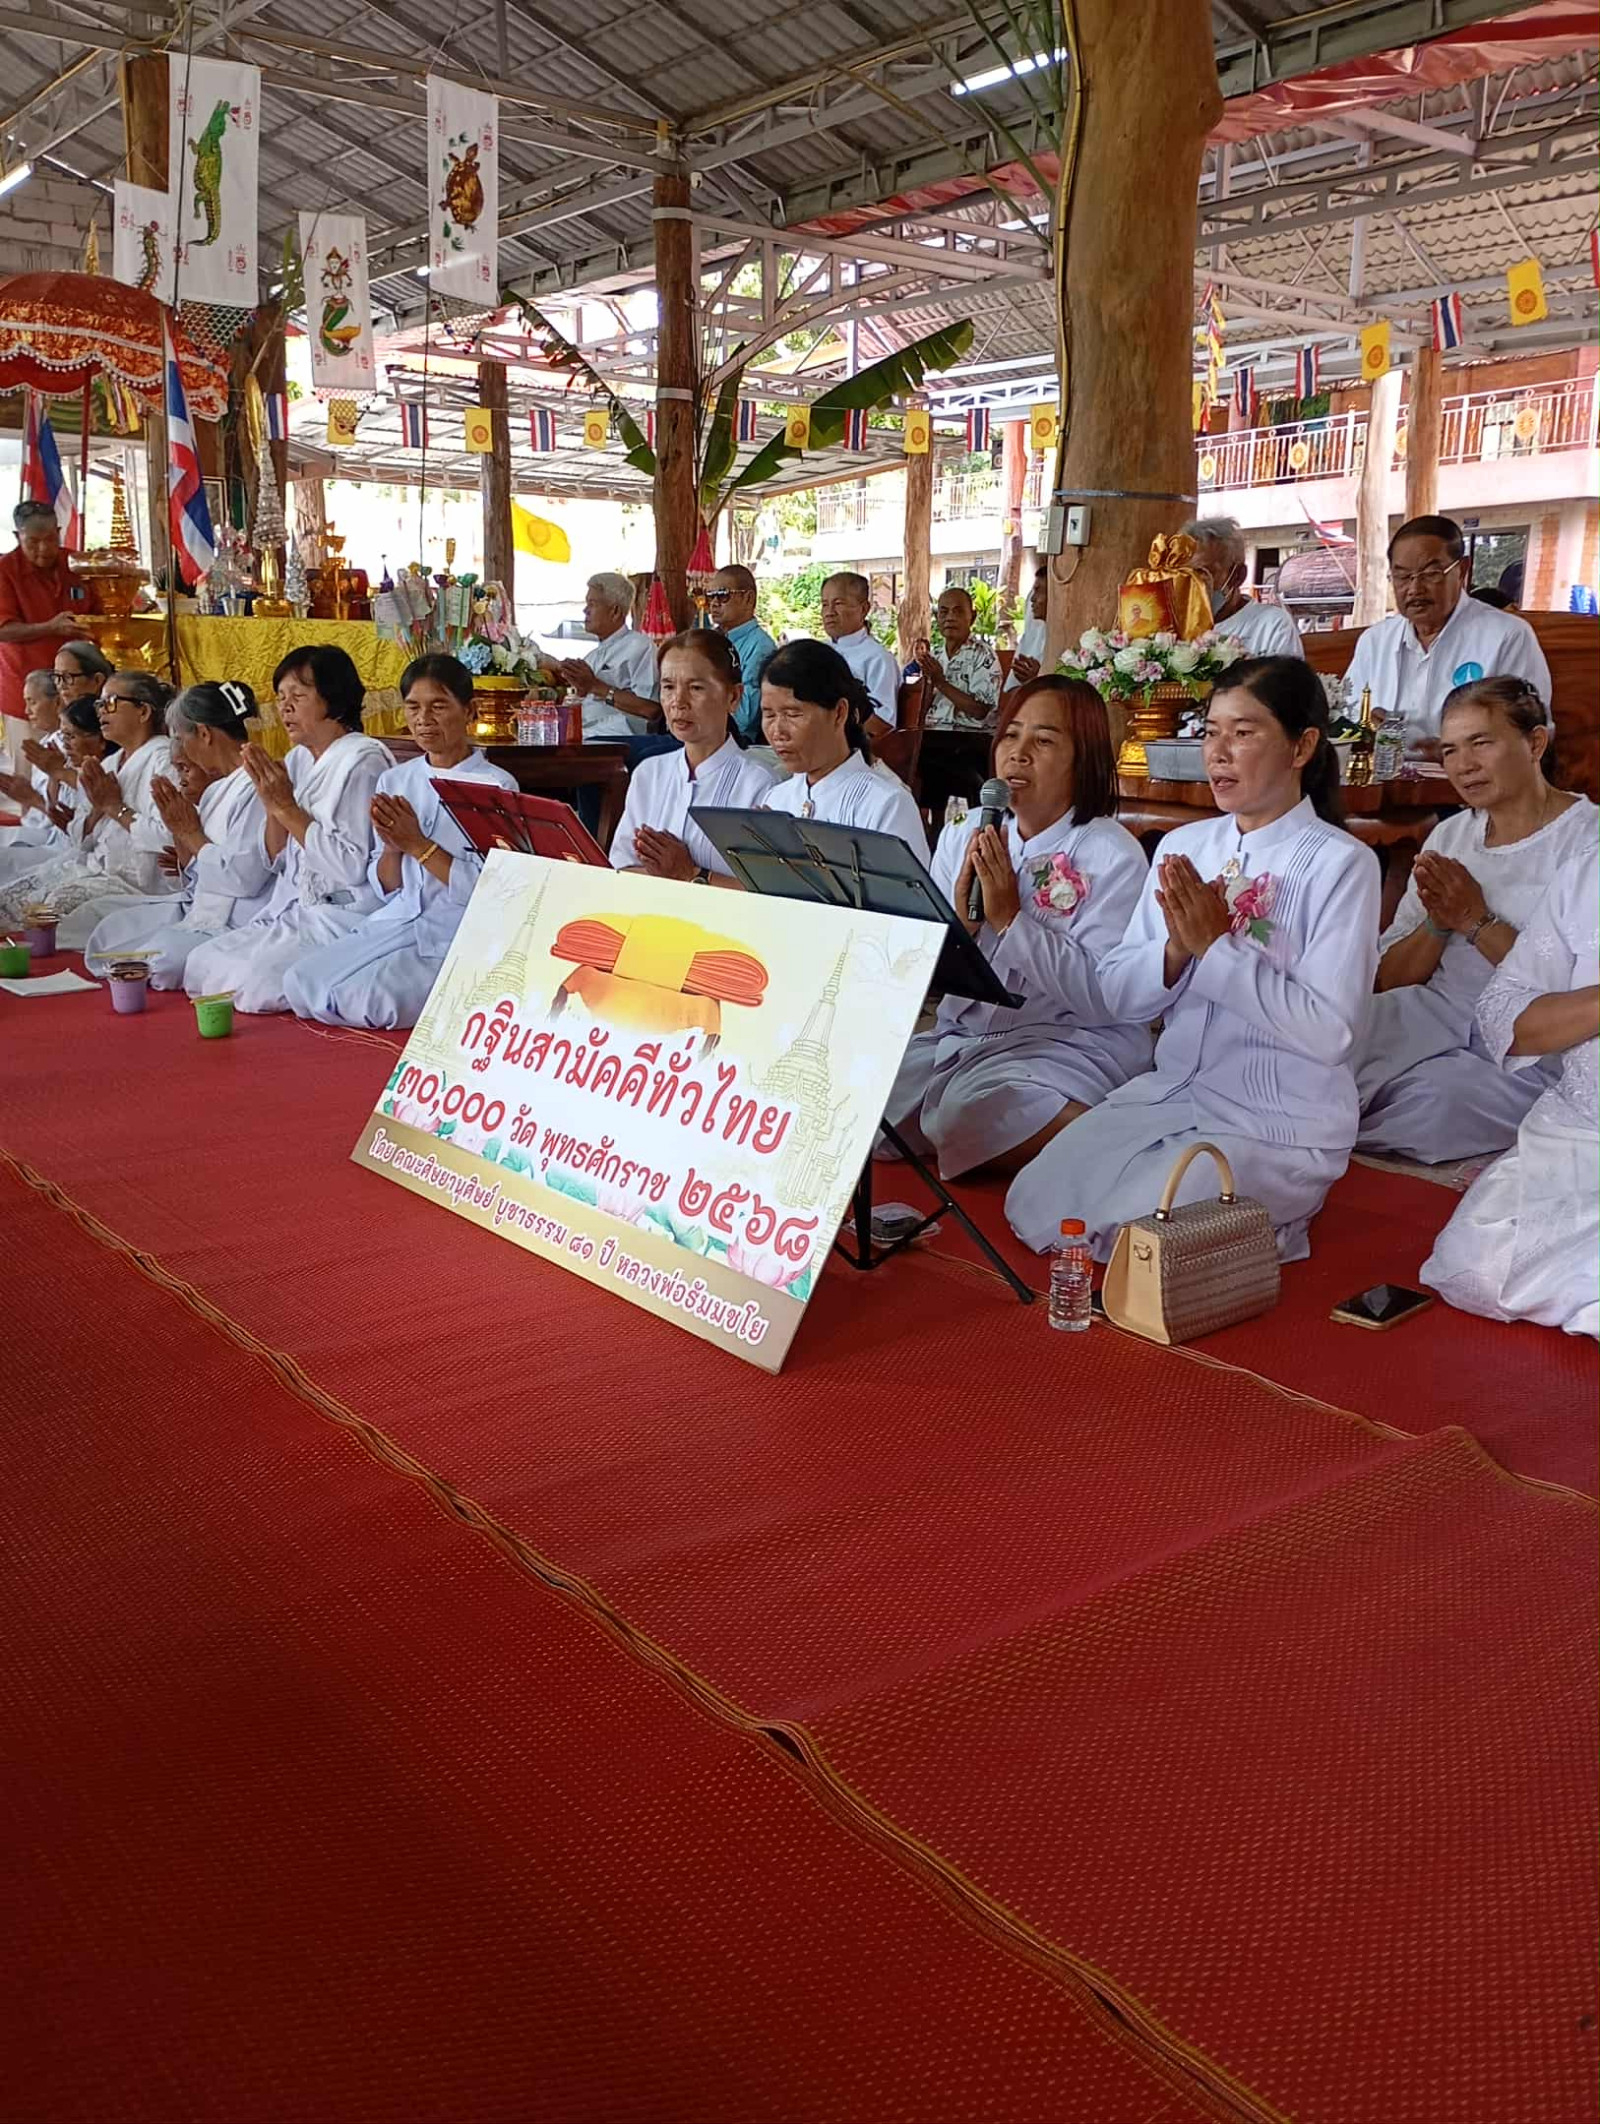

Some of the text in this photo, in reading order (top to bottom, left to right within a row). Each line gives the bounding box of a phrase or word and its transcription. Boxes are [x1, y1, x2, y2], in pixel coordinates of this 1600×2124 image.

[397, 1064, 819, 1261] ๓๐,๐๐๐ วัด พุทธศักราช ๒๕๖๘
[461, 1000, 791, 1154] กฐินสามัคคีทั่วไทย
[393, 1150, 500, 1207] คณะศิษยานุศิษย์
[495, 1198, 567, 1245] บูชาธรรม
[569, 1236, 593, 1259] ๘๑
[600, 1239, 616, 1267] ปี
[616, 1255, 766, 1341] หลวงพ่อธัมมชโย
